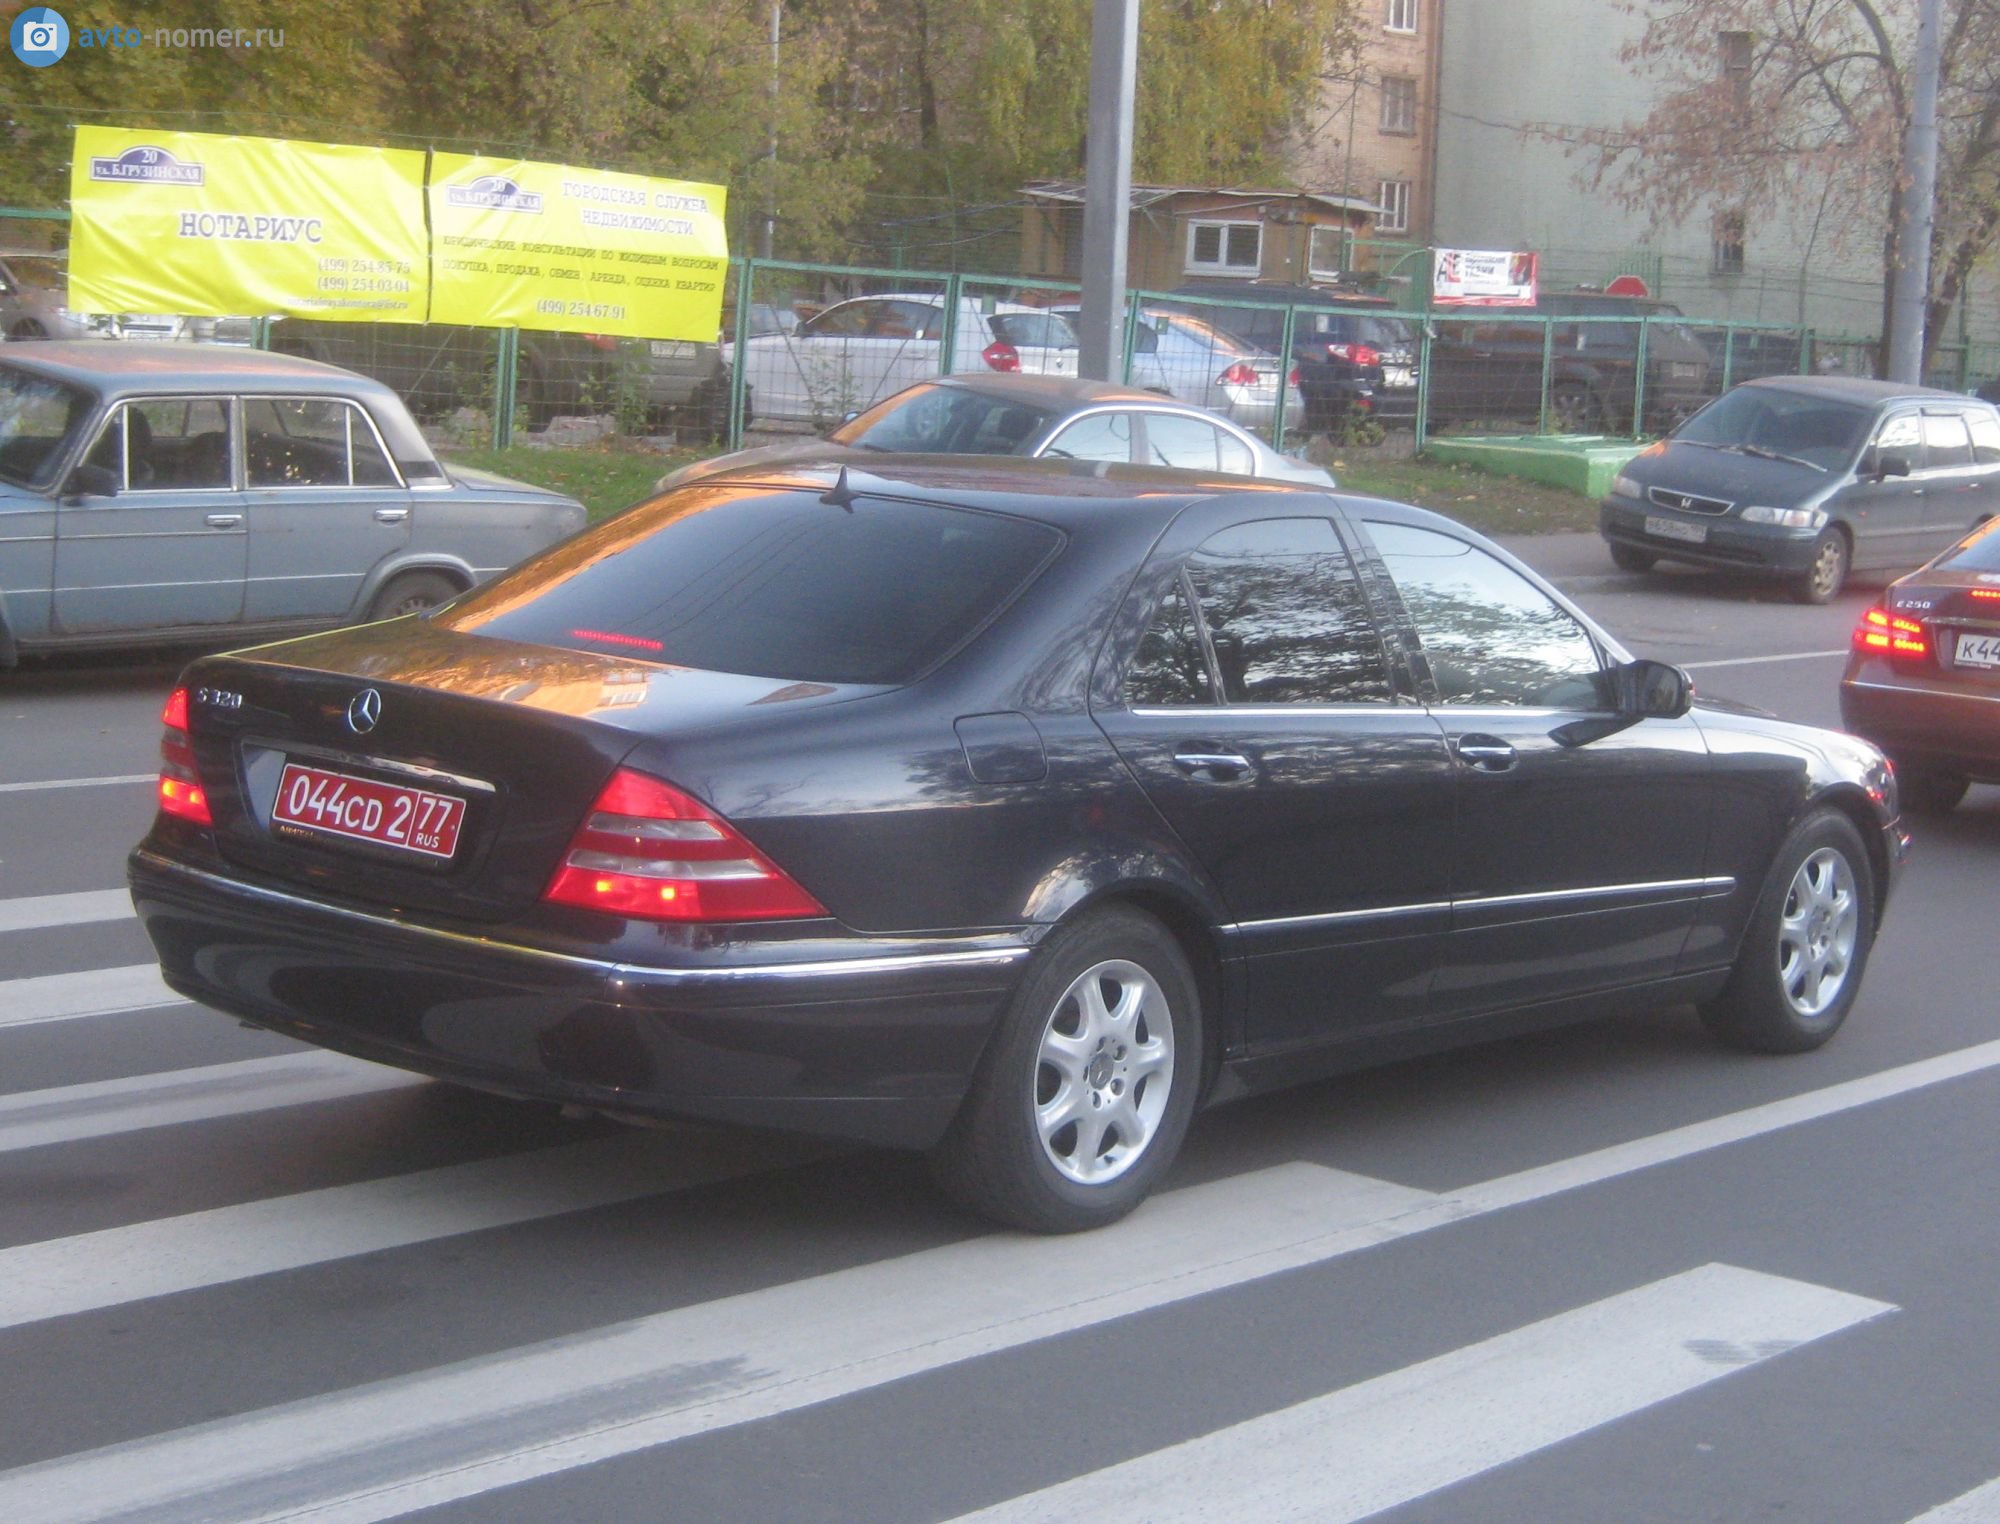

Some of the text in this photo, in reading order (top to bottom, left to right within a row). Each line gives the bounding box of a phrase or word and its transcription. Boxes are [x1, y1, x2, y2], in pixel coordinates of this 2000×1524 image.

[141, 150, 158, 164] 20
[112, 163, 200, 180] Б.ГРУЗИНСКАЯ
[563, 182, 647, 206] ГОРОДСКАЯ
[655, 194, 709, 213] СЛУЖБА
[180, 213, 321, 242] НОТАРИУС
[583, 209, 694, 236] НЕДВИЖИМОСТИ
[318, 258, 349, 273] (499)
[318, 276, 349, 292] (499)
[537, 299, 566, 317] (499)
[1906, 600, 1931, 609] 250
[211, 689, 242, 709] 320
[418, 796, 452, 834] 77
[416, 832, 440, 849] RUS
